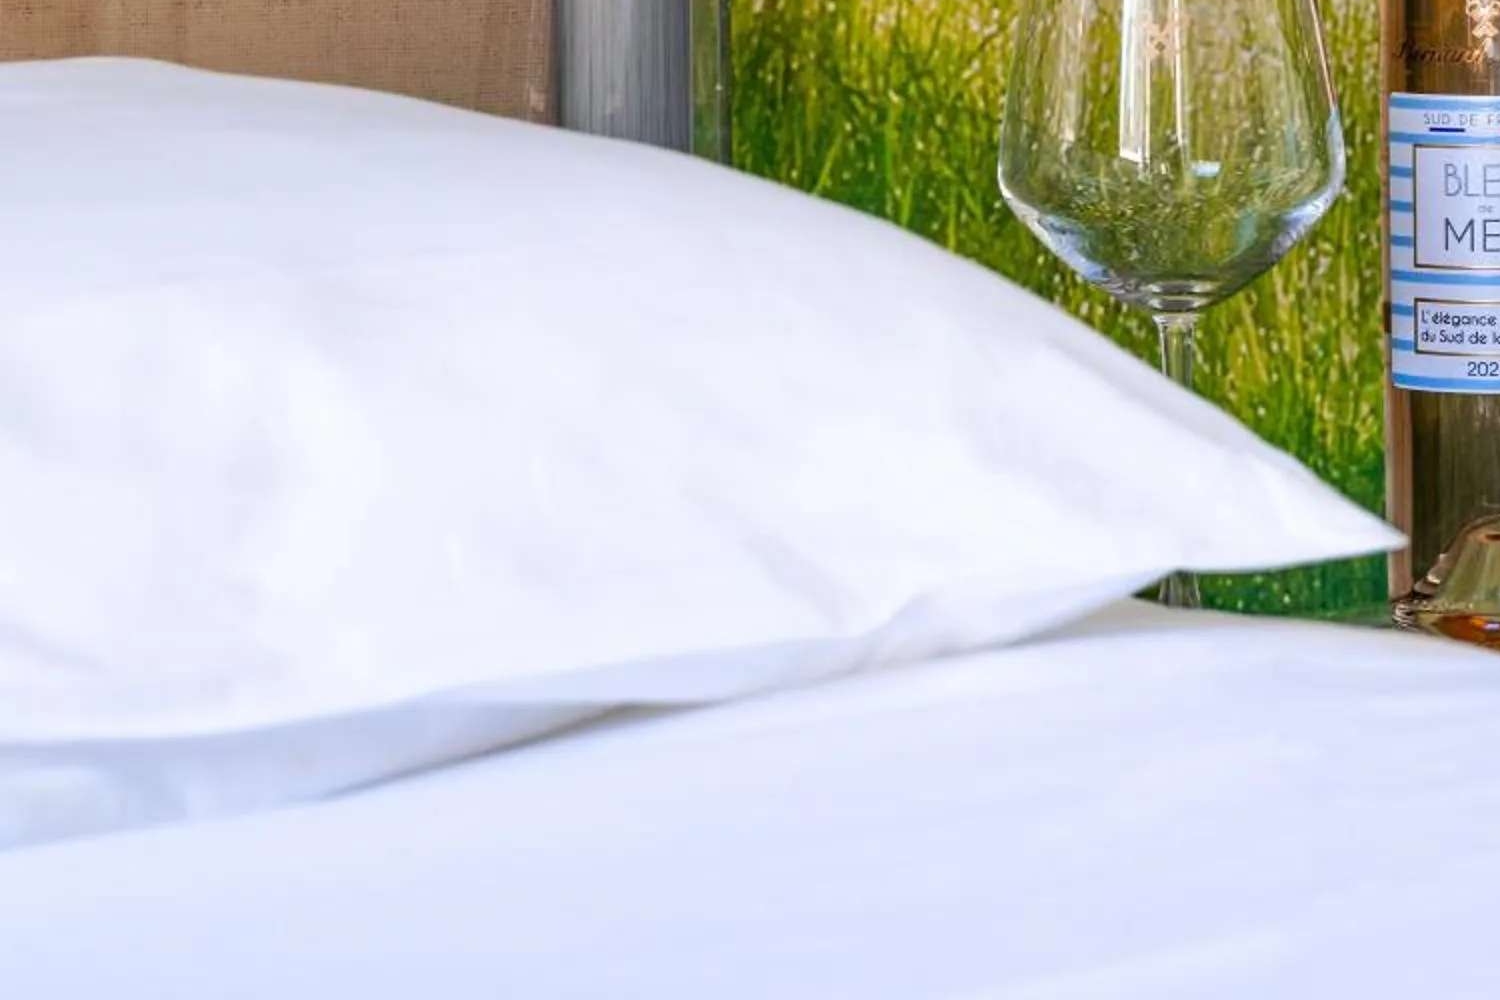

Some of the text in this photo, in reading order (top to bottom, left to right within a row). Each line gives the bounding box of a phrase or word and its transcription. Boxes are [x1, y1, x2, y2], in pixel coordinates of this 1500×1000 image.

[1423, 113, 1451, 125] SUD
[1460, 113, 1478, 126] DE
[1421, 309, 1497, 328] L'élégance
[1421, 330, 1437, 343] du
[1439, 330, 1465, 344] Sud
[1468, 331, 1489, 345] de
